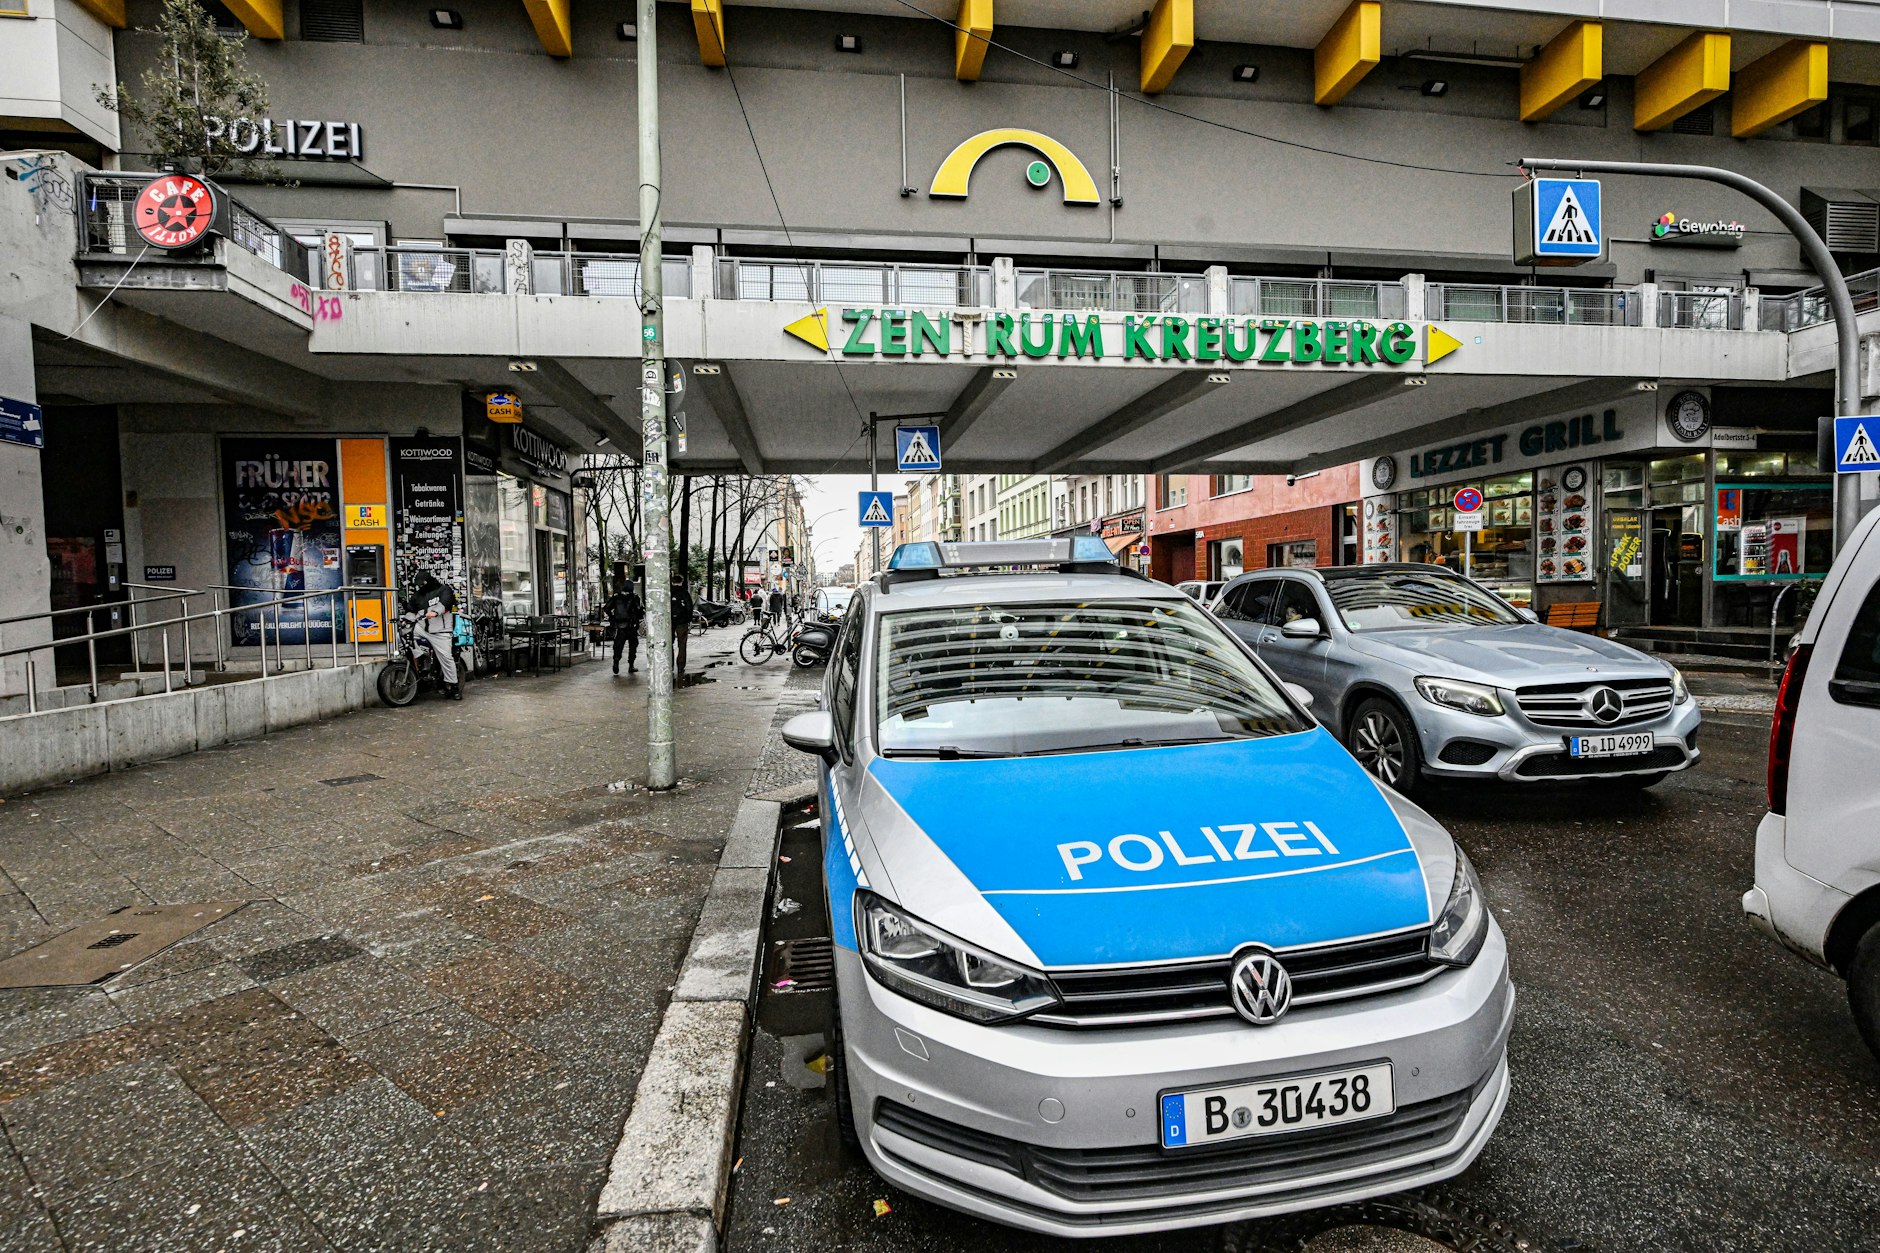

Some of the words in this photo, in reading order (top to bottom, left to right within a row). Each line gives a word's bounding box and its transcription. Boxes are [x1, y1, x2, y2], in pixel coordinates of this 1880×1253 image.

[203, 115, 361, 157] POLIZEI
[149, 181, 205, 203] CAFÉ
[148, 226, 198, 243] KOTTI
[1679, 219, 1745, 239] Gewobag
[842, 309, 1105, 359] ZENTRUM
[1123, 315, 1416, 364] KREUZBERG
[400, 448, 453, 457] KOTTIWOOD
[512, 423, 568, 471] KOTTIWOOD
[1410, 434, 1508, 479] LEZZET
[1519, 409, 1625, 457] GRILL
[235, 453, 331, 489] FRÜHER
[410, 482, 447, 492] Tabakwaren
[415, 499, 445, 508] Getränke
[353, 519, 380, 527] CASH
[410, 515, 452, 523] Weinsortiment
[1716, 515, 1741, 526] Cash
[416, 546, 449, 555] Spirituosen
[147, 567, 173, 575] POLIZEI
[1581, 739, 1590, 753] B
[1600, 738, 1615, 752] ID
[1618, 735, 1650, 751] 4999
[1056, 821, 1340, 881] POLIZEI
[1205, 1095, 1230, 1135] B
[1257, 1074, 1372, 1127] 30438
[1170, 1125, 1180, 1137] D
